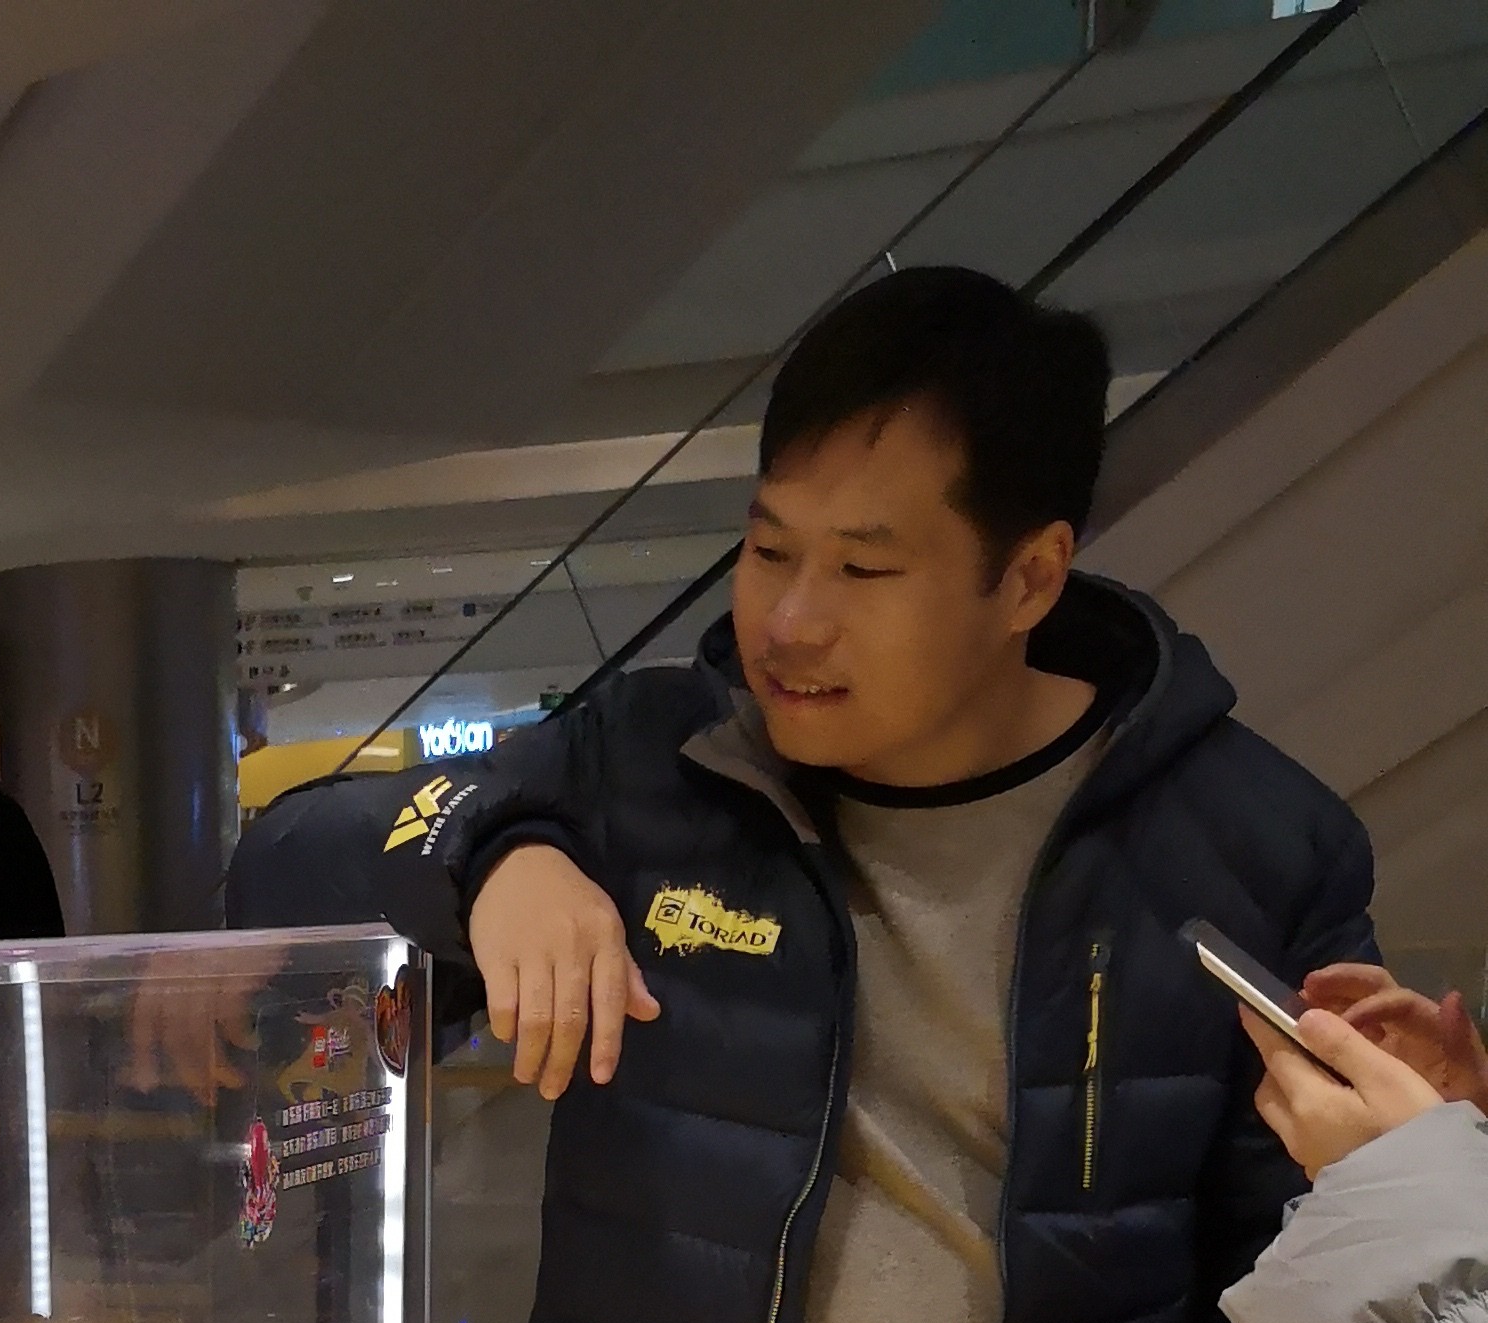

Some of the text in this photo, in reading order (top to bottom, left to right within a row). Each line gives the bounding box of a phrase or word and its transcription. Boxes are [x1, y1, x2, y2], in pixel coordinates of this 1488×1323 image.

[75, 782, 104, 805] L2
[420, 783, 479, 856] WITH FAITH
[687, 911, 767, 947] TOREAD
